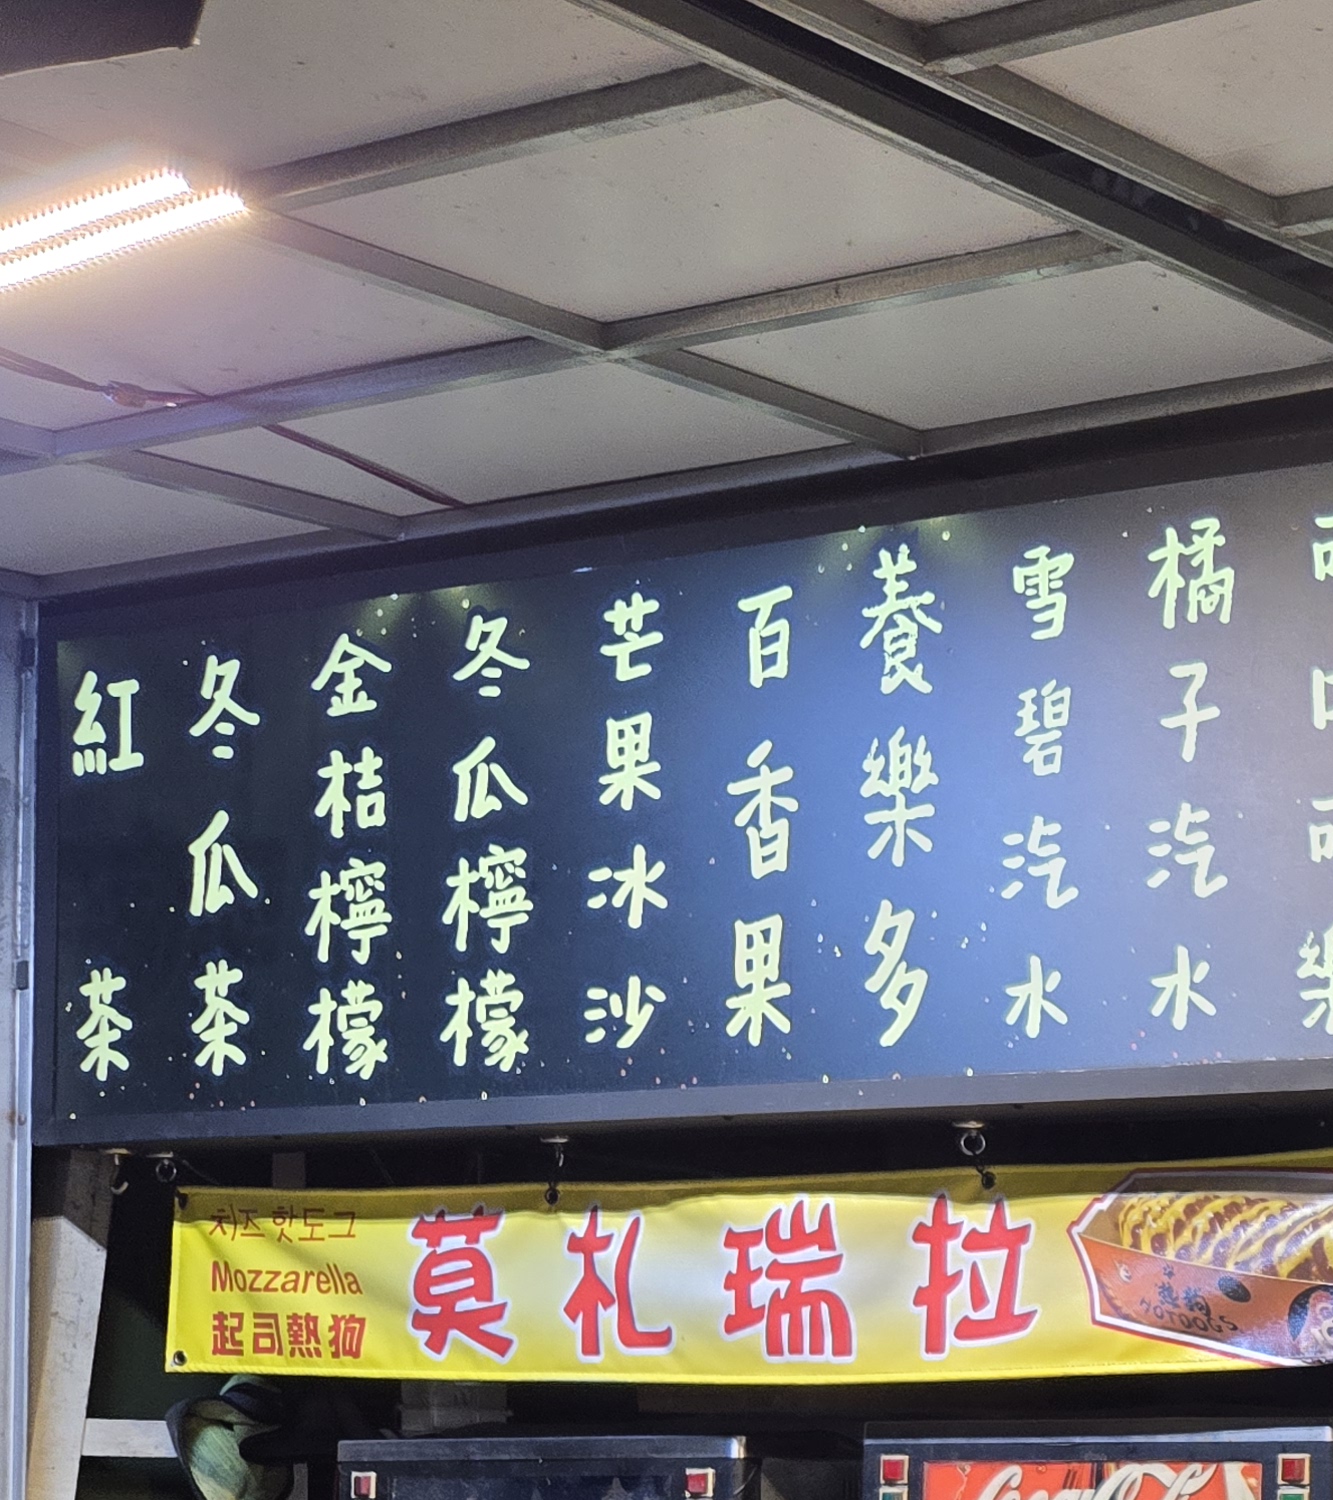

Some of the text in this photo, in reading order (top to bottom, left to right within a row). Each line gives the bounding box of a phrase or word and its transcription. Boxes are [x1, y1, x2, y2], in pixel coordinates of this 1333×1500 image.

[72, 670, 144, 1082] 紅茶
[187, 655, 261, 1077] 冬瓜茶
[303, 632, 393, 1081] 金桔檸檬
[439, 614, 534, 1073] 冬瓜檸檬
[584, 592, 668, 1049] 芒果冰沙
[725, 585, 799, 1047] 百香果
[859, 544, 942, 1048] 養樂多
[1001, 544, 1078, 1038] 雪碧汽水
[1147, 517, 1235, 1031] 橘子汽水
[209, 1204, 356, 1243] 치즈 핫도그
[211, 1260, 363, 1295] Mozzarella
[211, 1310, 367, 1360] 起司熱狗
[409, 1193, 1038, 1360] 莫札瑞拉
